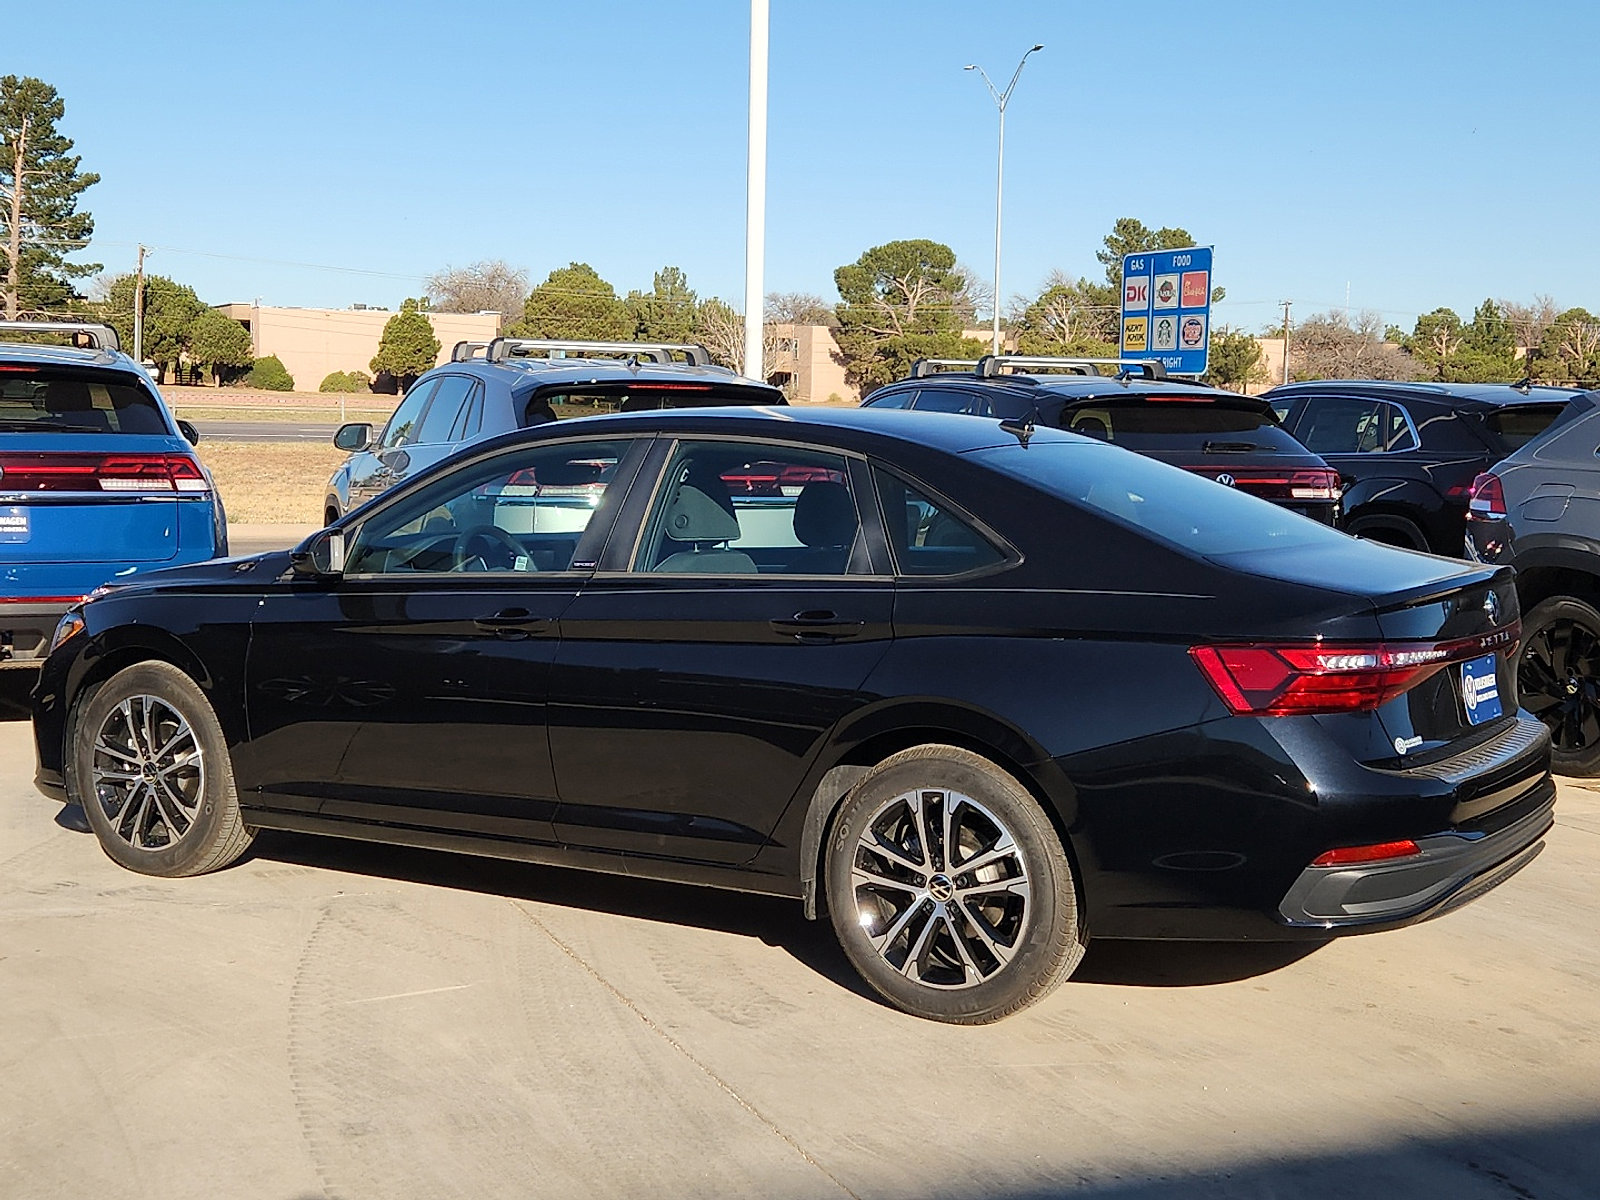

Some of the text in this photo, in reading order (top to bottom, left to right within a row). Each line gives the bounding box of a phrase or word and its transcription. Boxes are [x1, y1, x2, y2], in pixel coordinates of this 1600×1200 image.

[1130, 259, 1145, 271] GAS
[1172, 254, 1192, 268] FOOD
[1126, 284, 1148, 303] DK
[1162, 356, 1183, 369] RIGHT
[1480, 632, 1510, 648] JETTA
